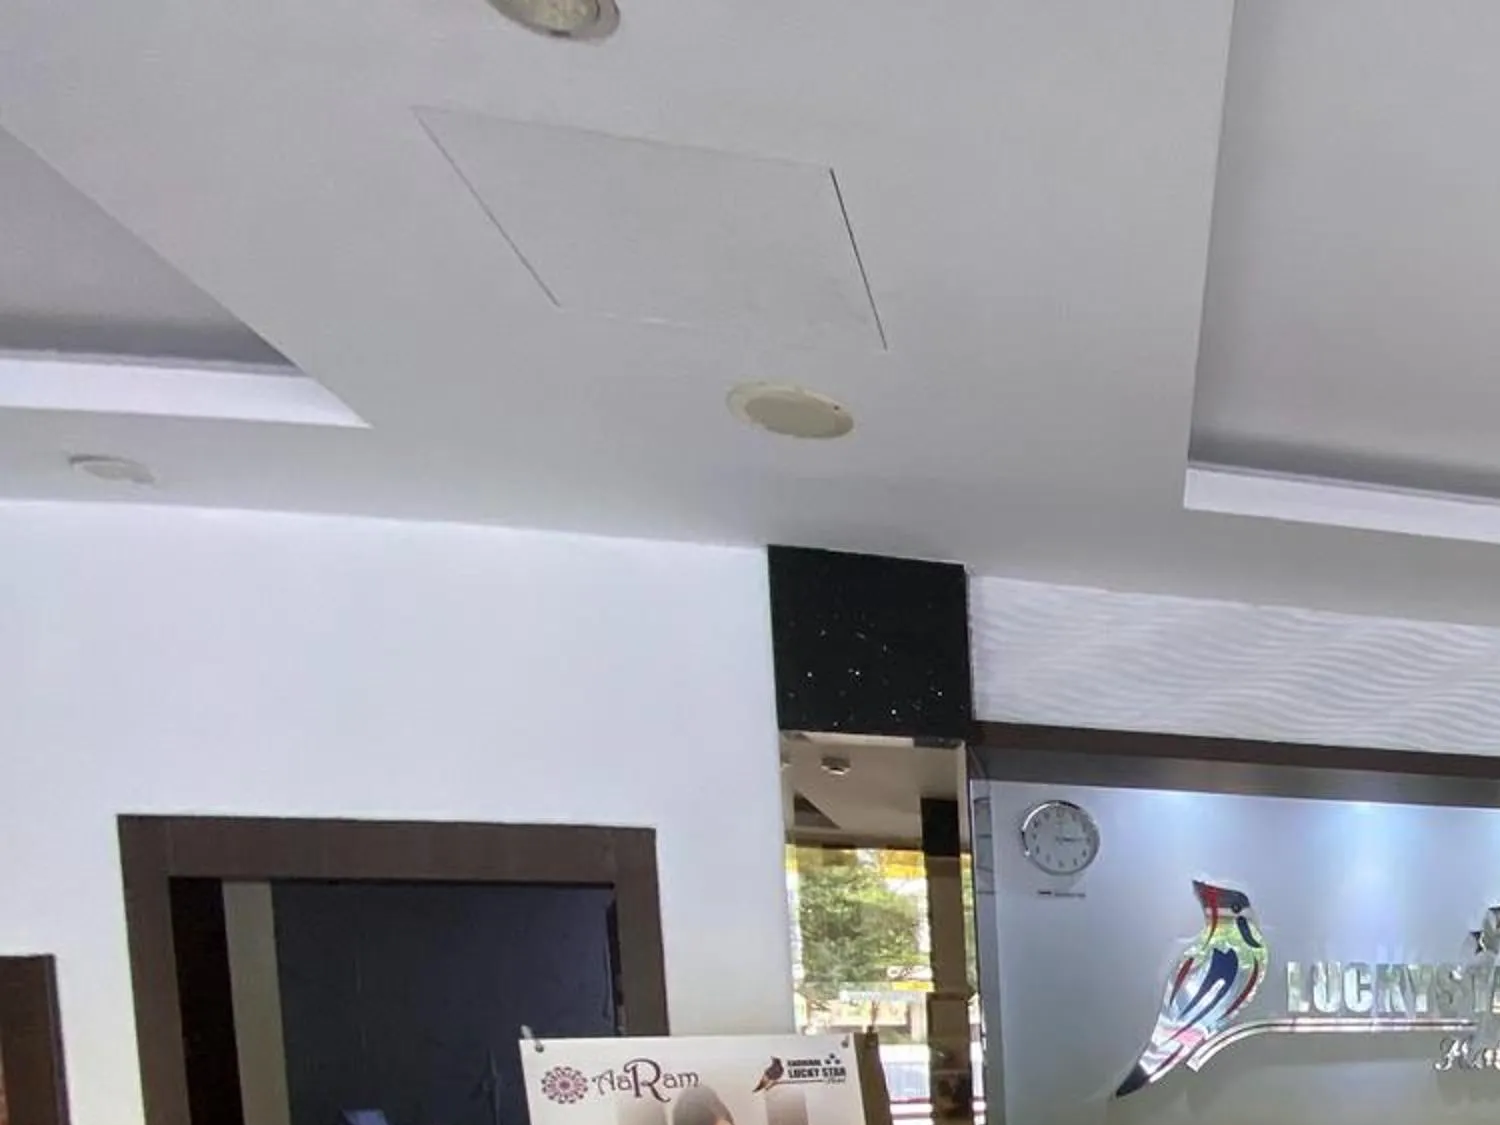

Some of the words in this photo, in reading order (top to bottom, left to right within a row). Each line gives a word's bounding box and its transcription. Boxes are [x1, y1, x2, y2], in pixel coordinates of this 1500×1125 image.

[591, 1058, 699, 1103] AaRam
[787, 1067, 820, 1079] LUCKY
[822, 1066, 847, 1078] STAR
